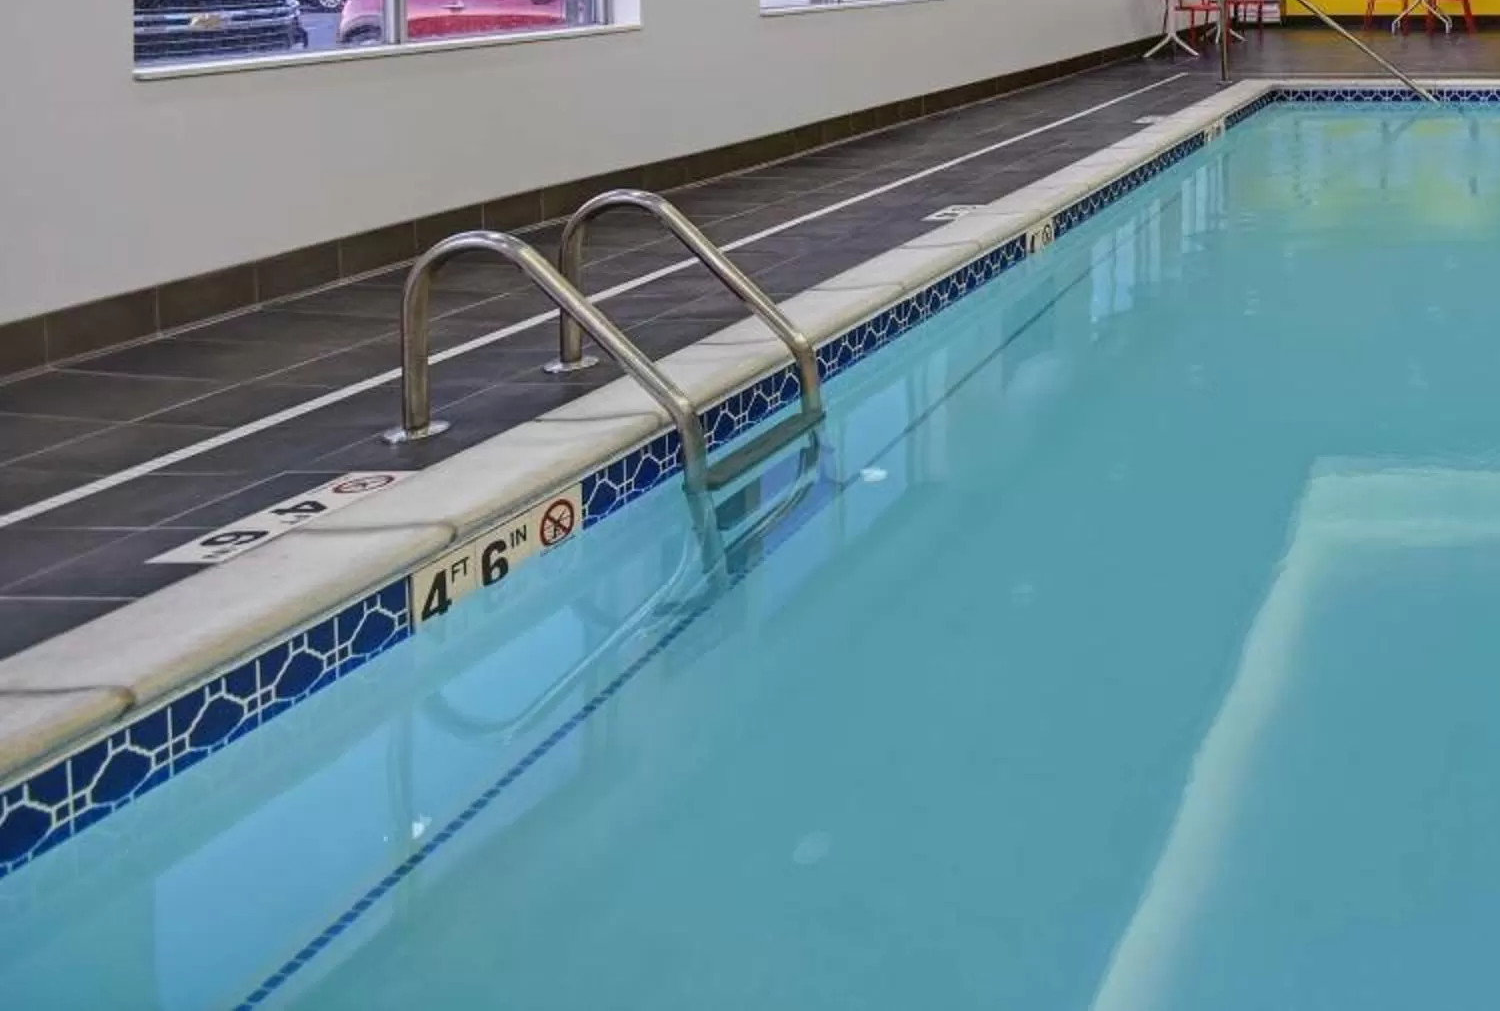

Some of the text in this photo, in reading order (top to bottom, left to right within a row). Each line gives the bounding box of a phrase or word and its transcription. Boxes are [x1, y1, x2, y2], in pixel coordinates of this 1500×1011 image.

[271, 500, 328, 516] 4
[421, 568, 452, 621] 4
[451, 556, 469, 584] FT
[481, 539, 509, 587] 6
[509, 524, 528, 549] IN
